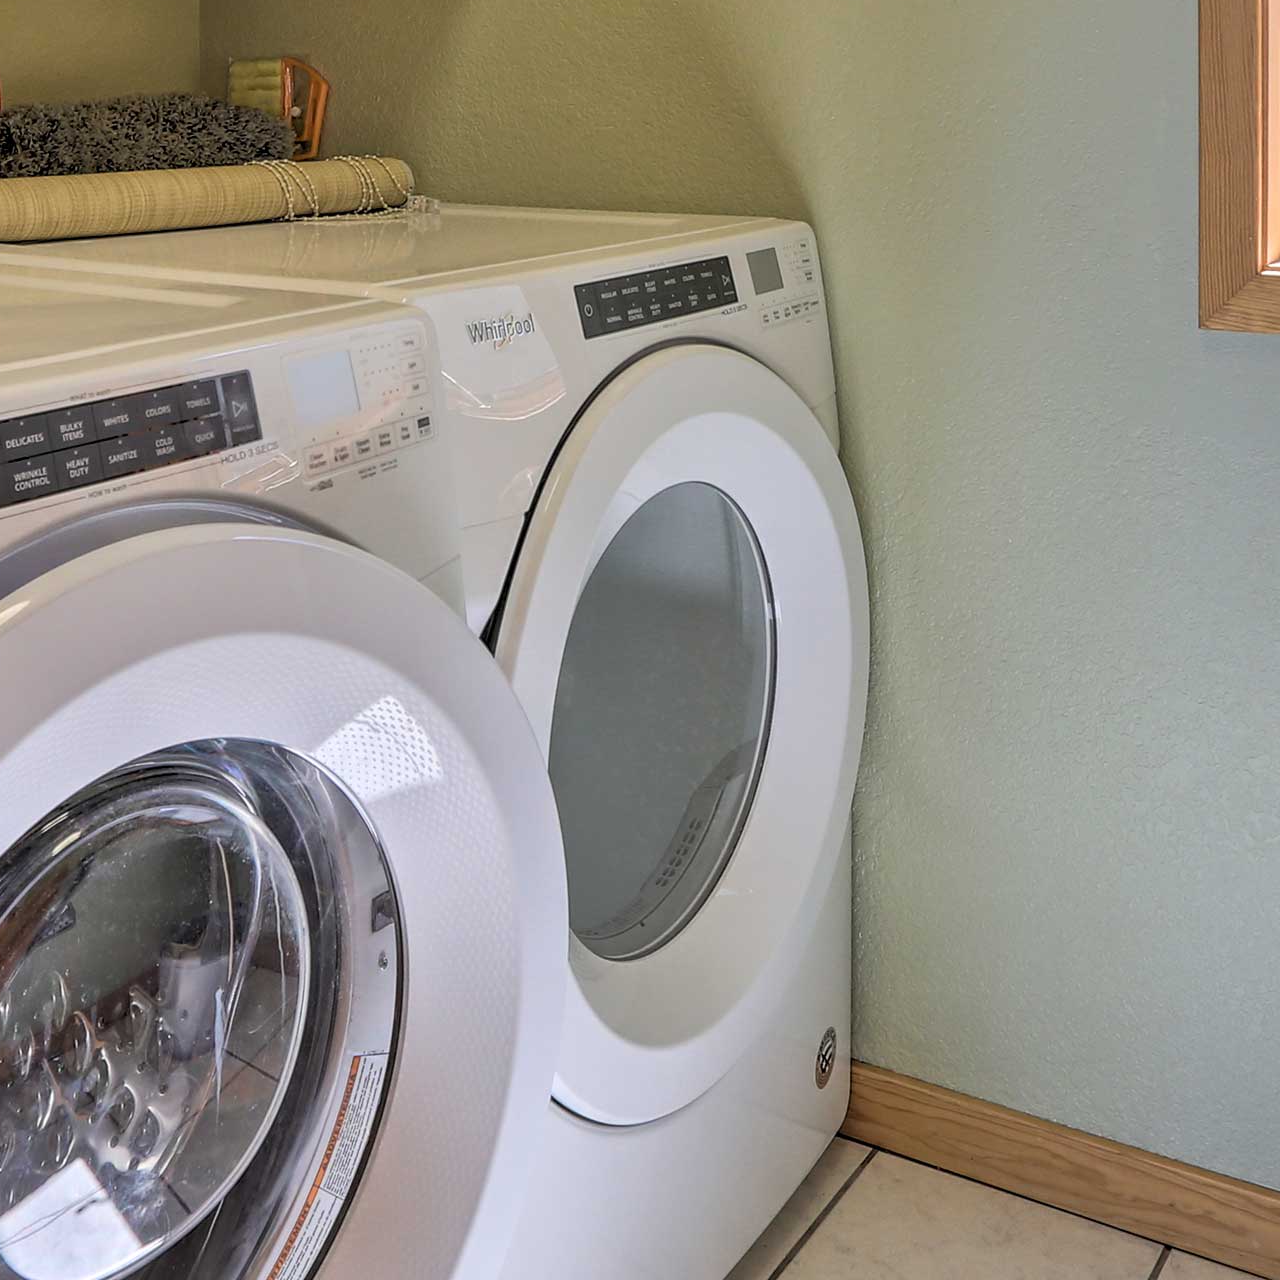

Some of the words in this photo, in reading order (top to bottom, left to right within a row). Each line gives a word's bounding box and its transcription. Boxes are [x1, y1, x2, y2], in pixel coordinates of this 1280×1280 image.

[466, 312, 535, 343] Whirlpool
[145, 405, 171, 418] COLORS
[60, 421, 83, 433] BULKY
[103, 414, 130, 427] WHITES
[6, 433, 44, 449] DELICATES
[62, 430, 84, 441] ITEMS
[155, 436, 173, 448] COLD
[195, 431, 215, 443] QUICK
[108, 449, 138, 465] SANITIZE
[156, 446, 176, 457] WASH
[221, 451, 246, 464] HOLD
[255, 442, 279, 456] SECS
[66, 457, 89, 470] HEAVY
[14, 467, 48, 482] WRINKLE
[69, 466, 89, 478] DUTY
[14, 477, 50, 492] CONTROL
